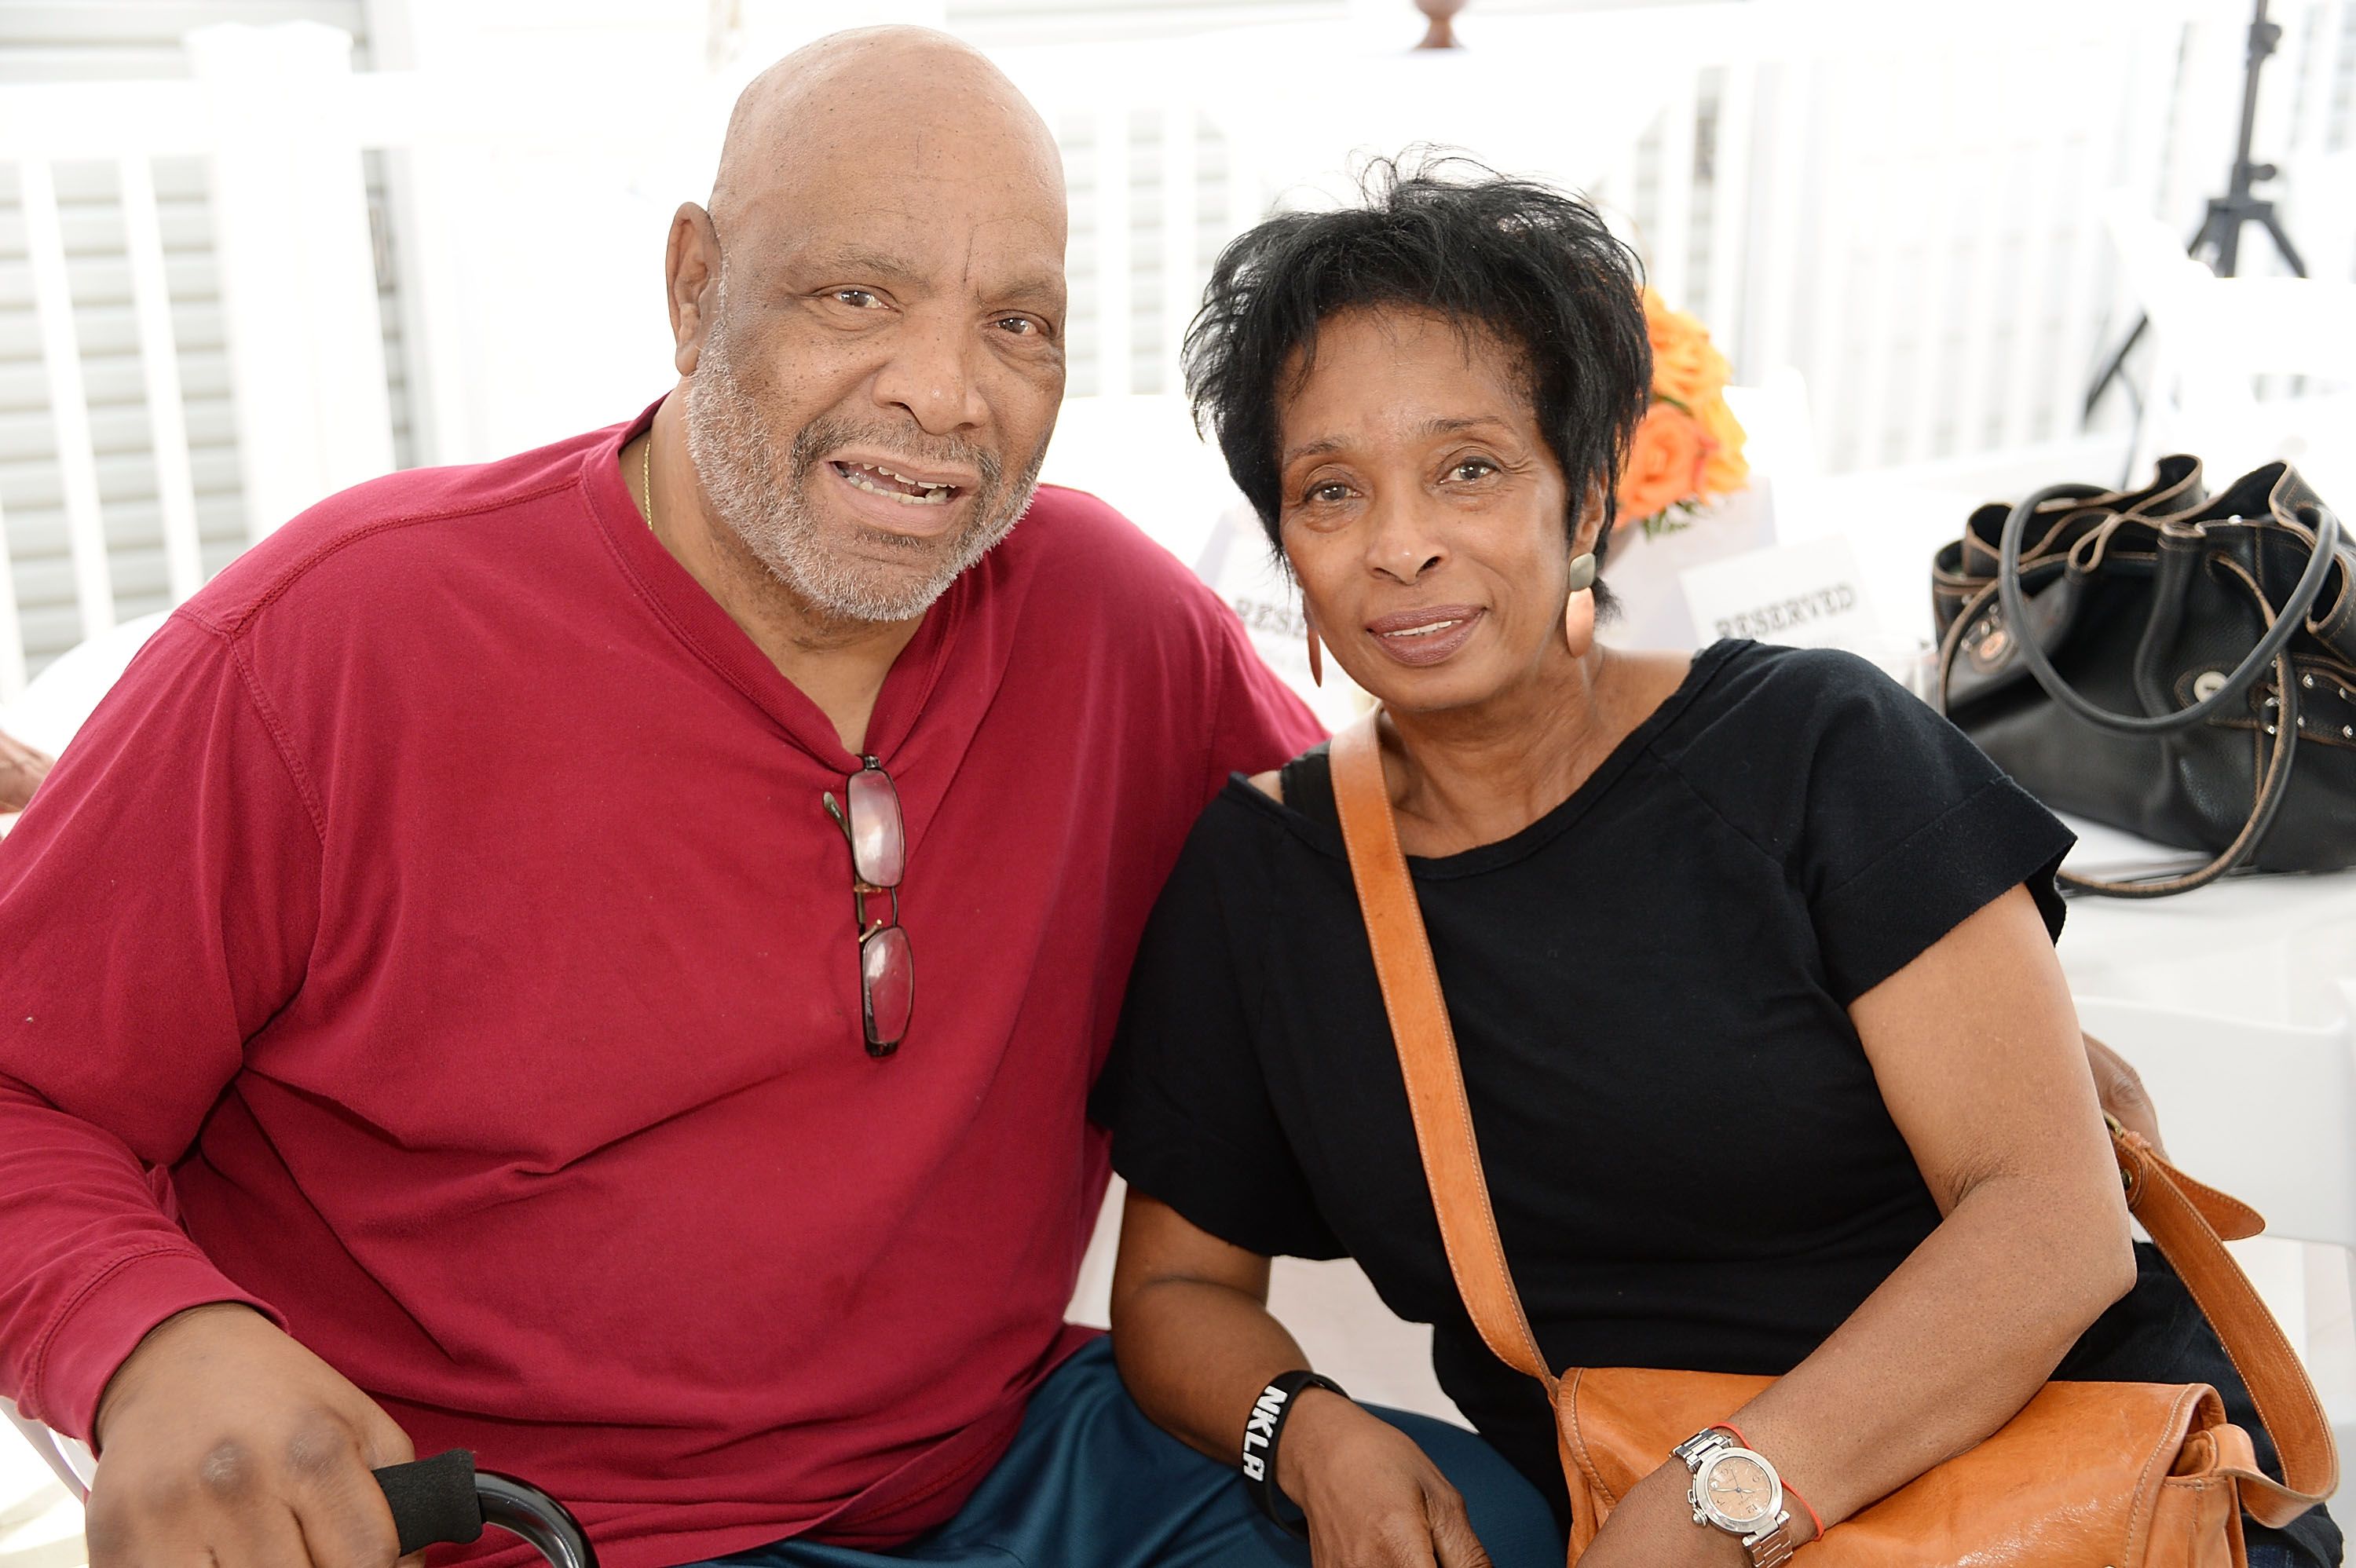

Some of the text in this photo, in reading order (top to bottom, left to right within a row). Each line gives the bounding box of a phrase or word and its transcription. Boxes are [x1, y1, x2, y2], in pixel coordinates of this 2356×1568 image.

[1714, 583, 1857, 640] RESERVED
[1242, 1385, 1288, 1482] NKLA
[1746, 1503, 1758, 1515] 12
